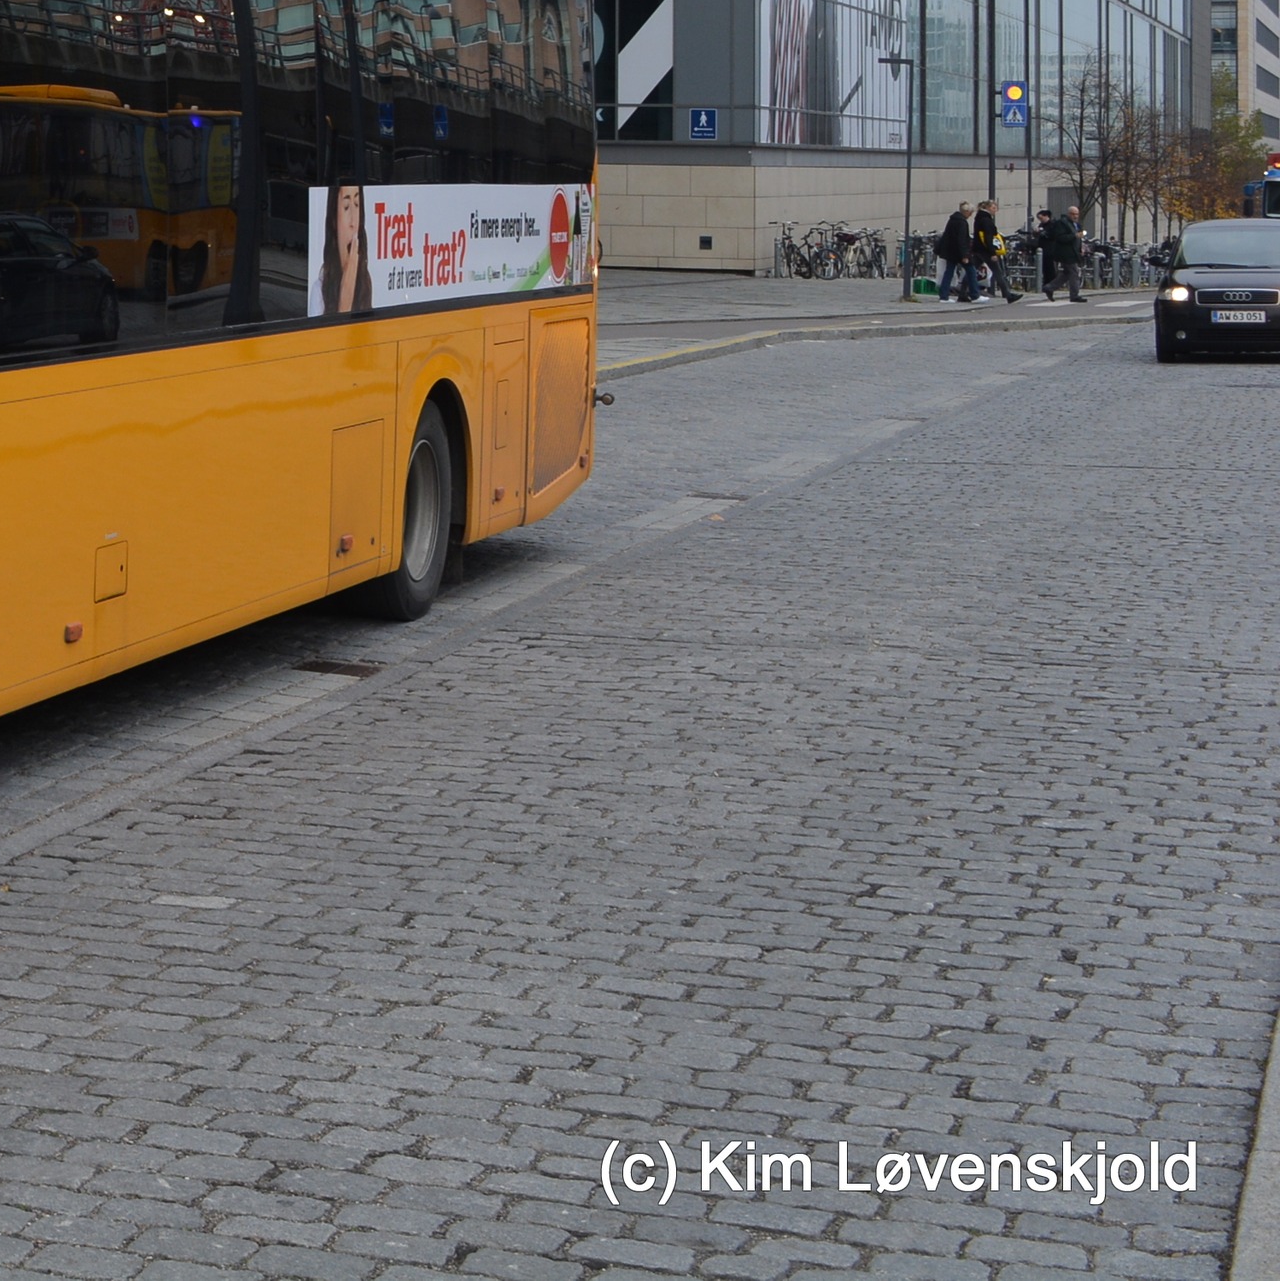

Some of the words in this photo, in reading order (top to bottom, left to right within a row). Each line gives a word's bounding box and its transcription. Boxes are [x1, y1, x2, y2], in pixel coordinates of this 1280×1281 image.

[374, 202, 413, 260] Træt
[470, 210, 479, 239] Få
[480, 218, 499, 238] mere
[501, 212, 523, 243] energi
[388, 266, 396, 291] af
[396, 266, 404, 290] at
[405, 269, 422, 289] være
[423, 229, 466, 287] træt?
[1218, 312, 1231, 321] AW
[1232, 312, 1245, 321] 63
[1246, 312, 1263, 321] 051
